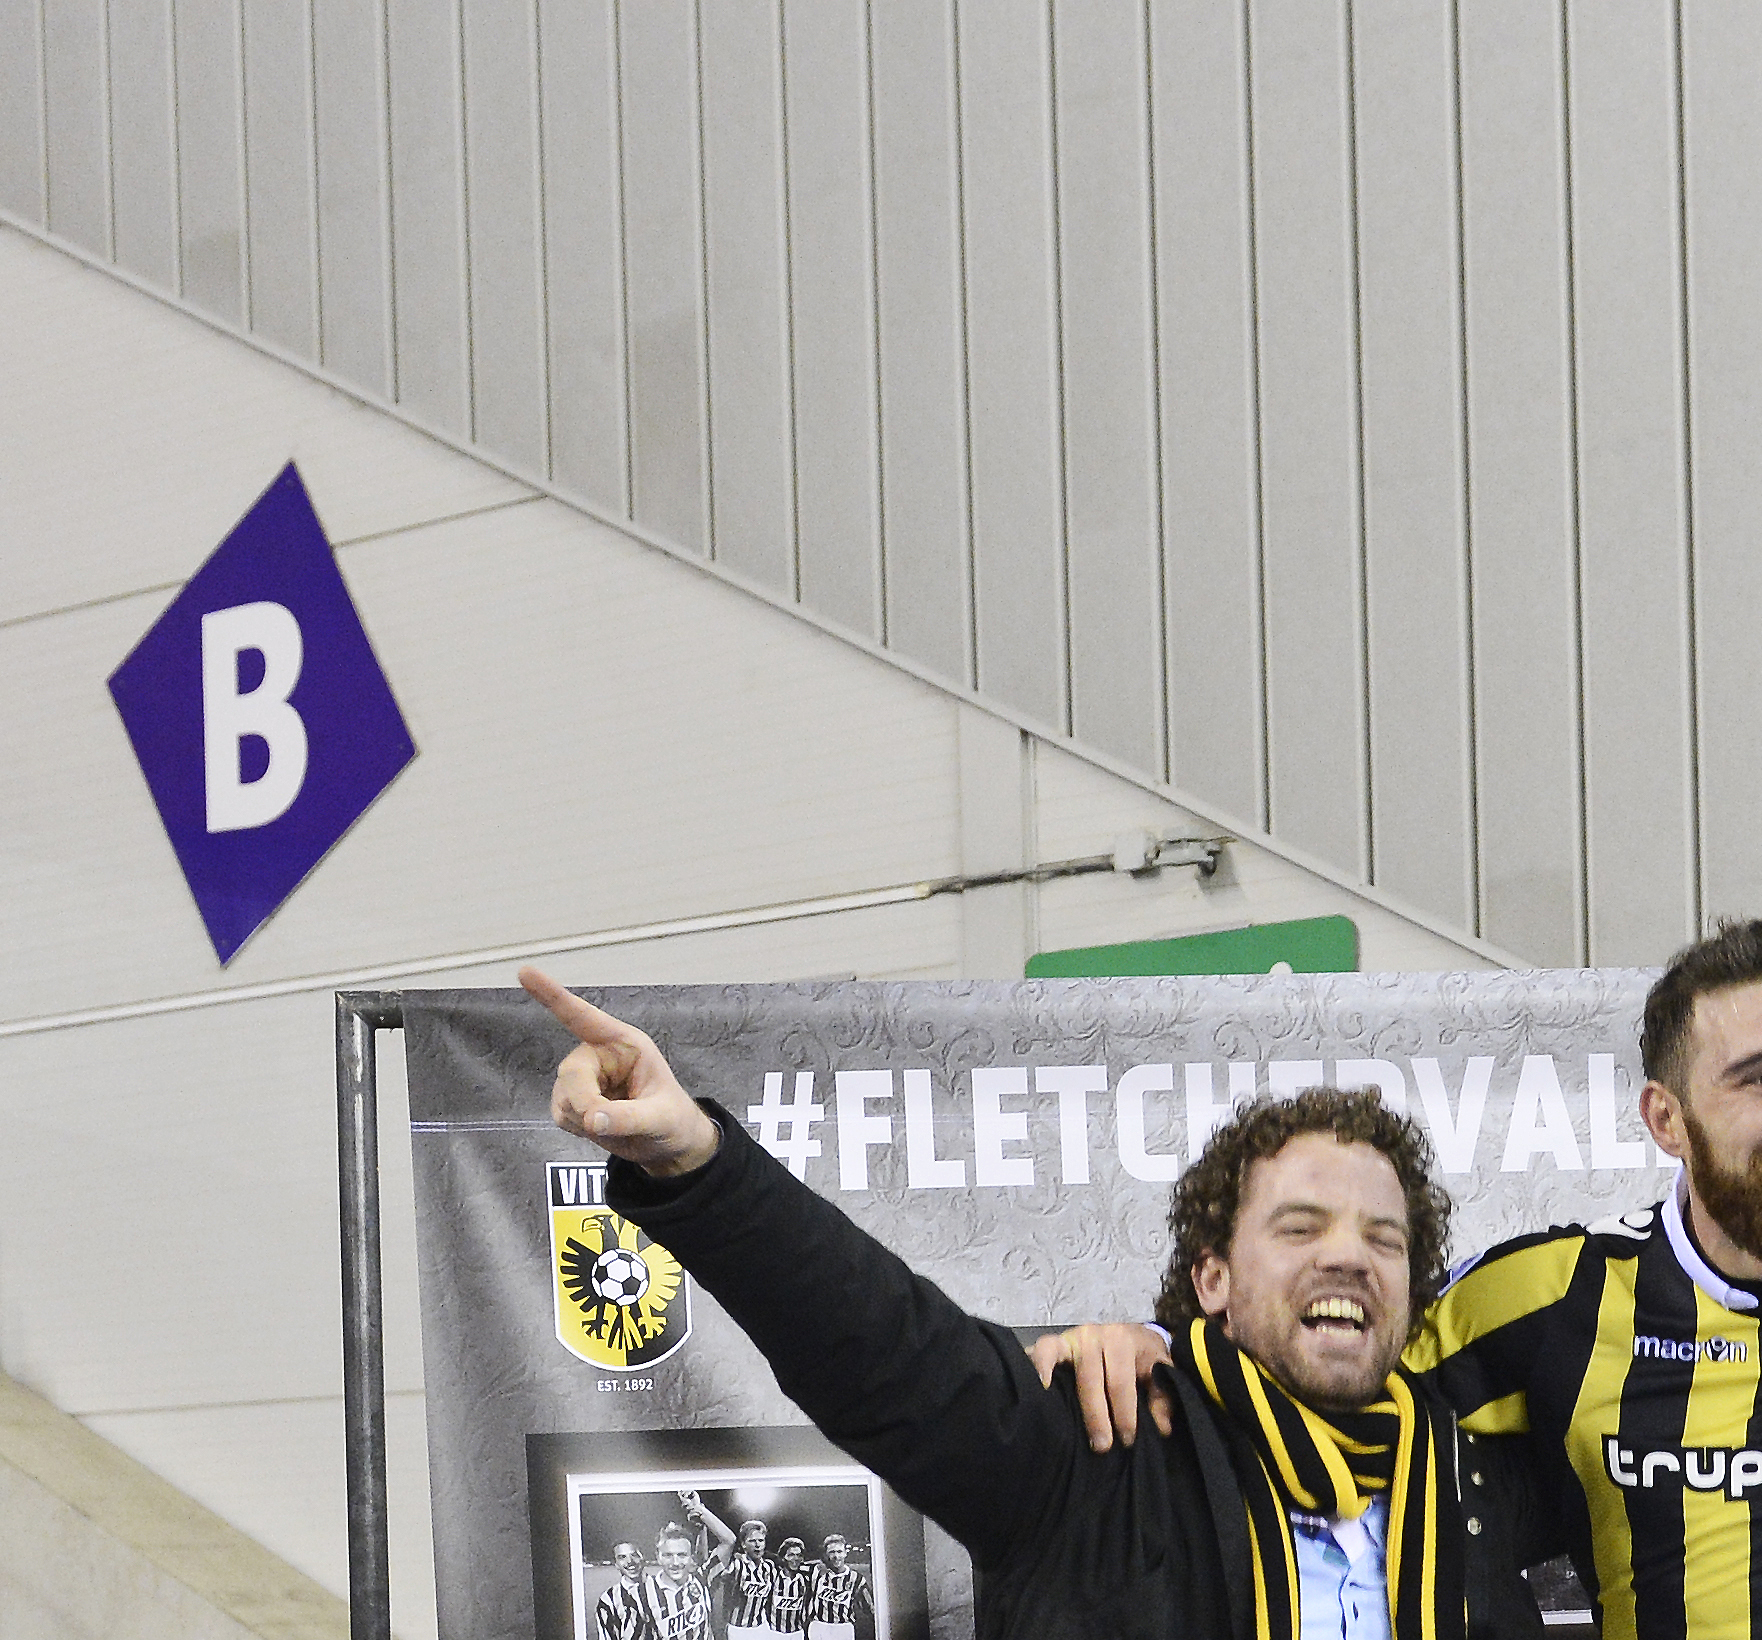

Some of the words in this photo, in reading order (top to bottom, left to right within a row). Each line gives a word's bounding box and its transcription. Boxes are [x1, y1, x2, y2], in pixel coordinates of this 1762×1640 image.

[201, 599, 308, 834] B
[558, 1167, 609, 1205] VIT
[1634, 1335, 1747, 1363] macron
[597, 1379, 621, 1392] EST.
[625, 1379, 654, 1392] 1892
